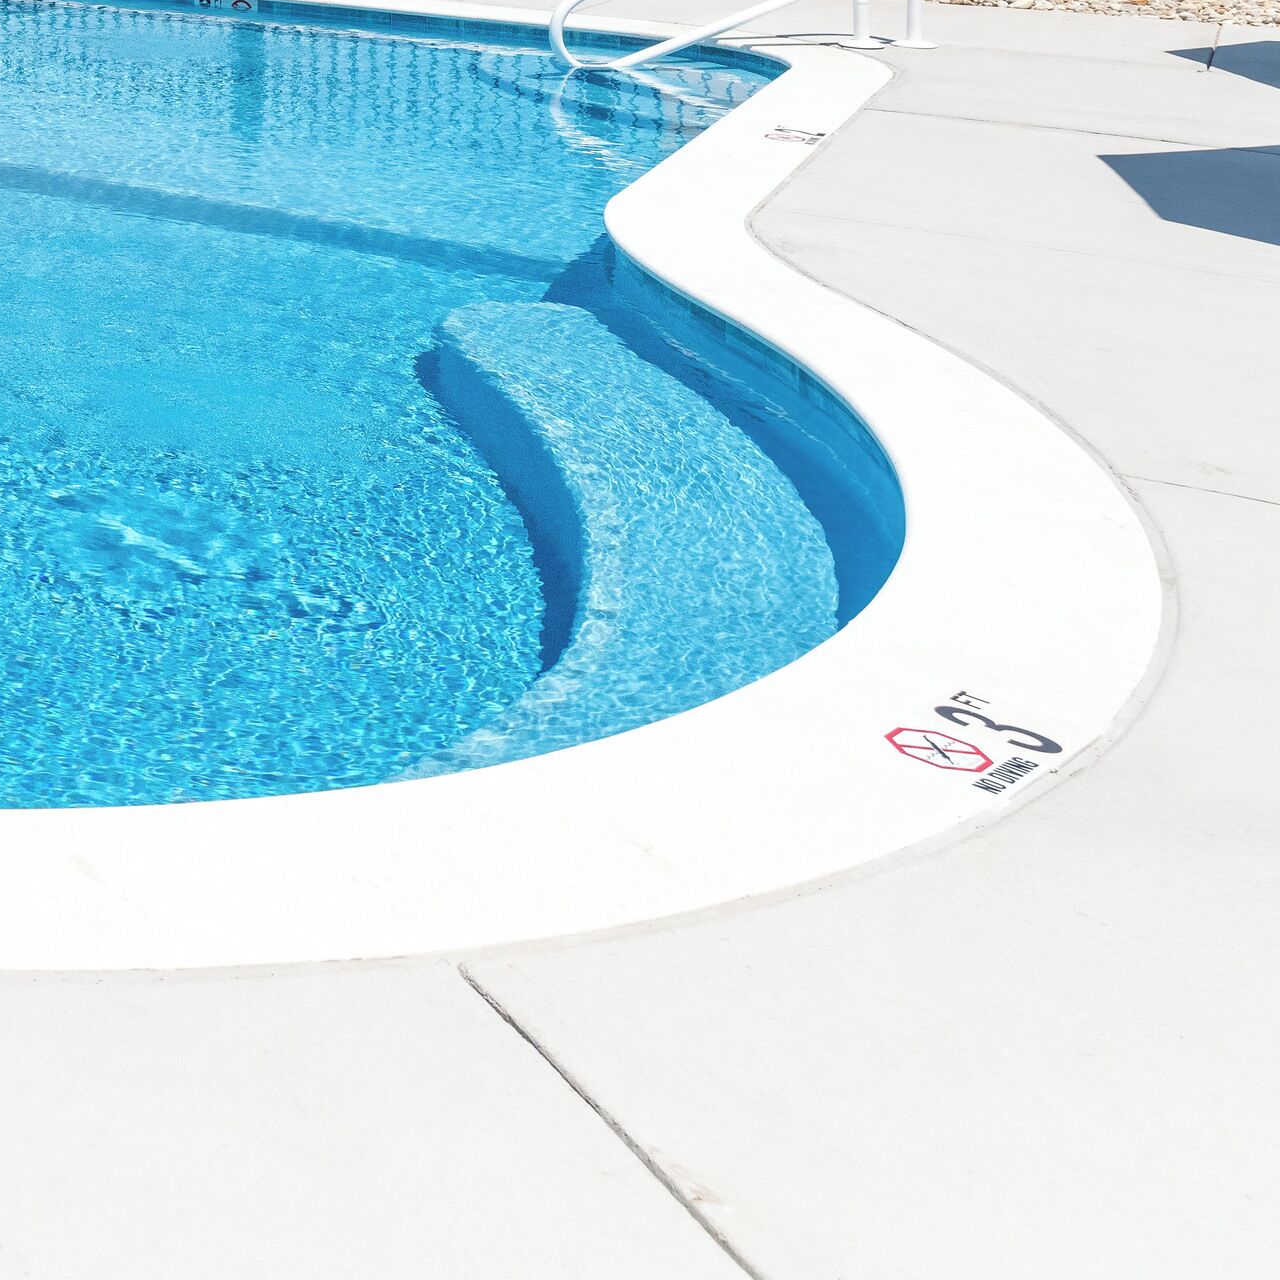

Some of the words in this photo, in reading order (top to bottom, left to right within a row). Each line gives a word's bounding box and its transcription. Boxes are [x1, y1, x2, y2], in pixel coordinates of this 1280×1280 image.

[950, 690, 990, 710] FT
[934, 705, 1063, 753] 3
[987, 756, 1040, 784] DIVING
[971, 778, 1007, 795] NO
